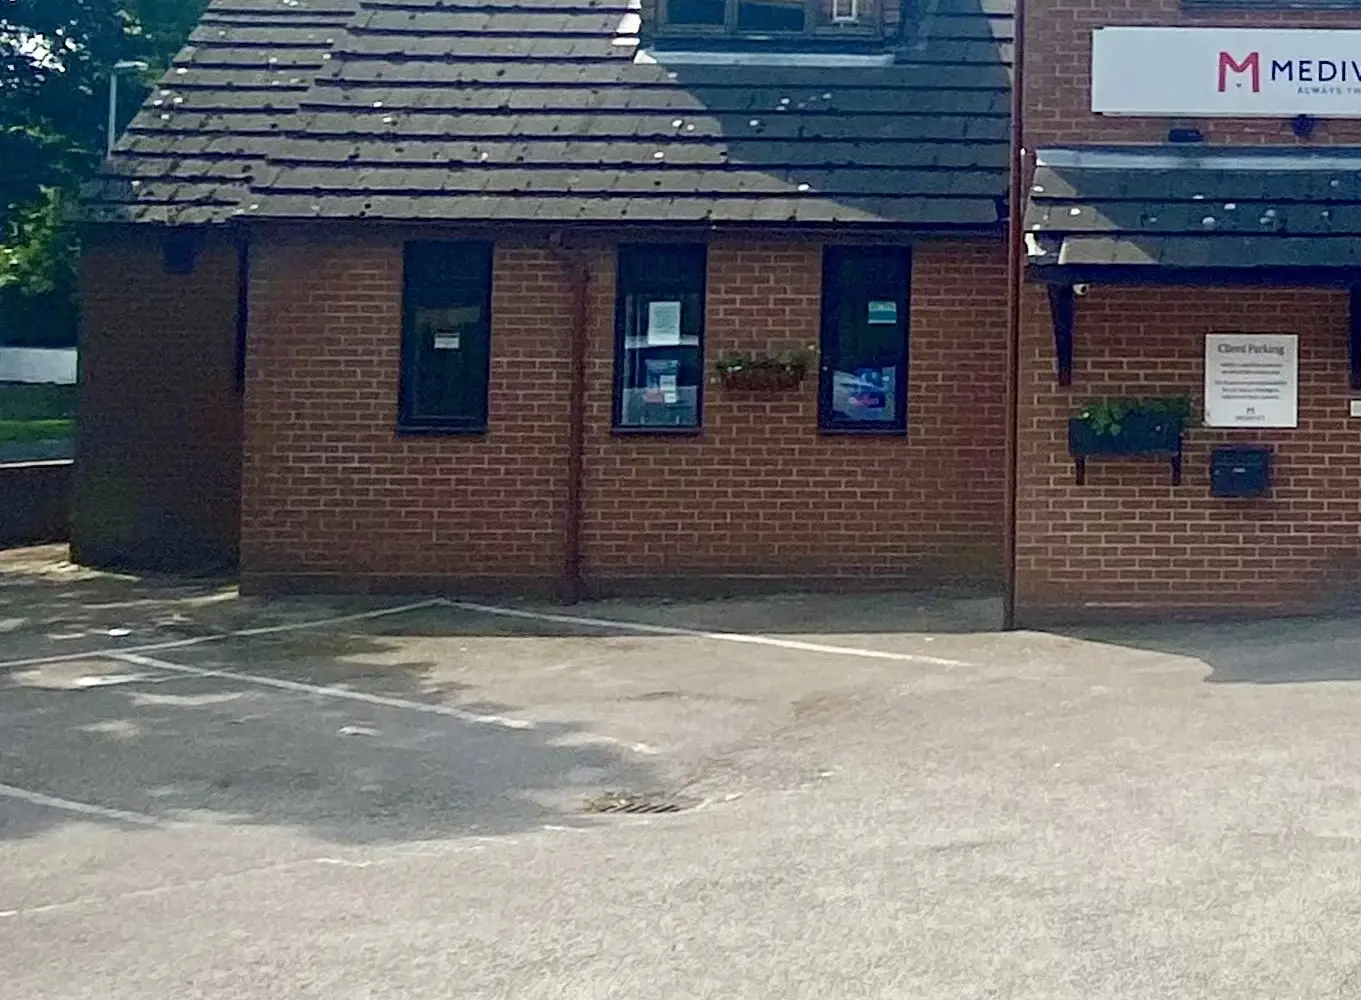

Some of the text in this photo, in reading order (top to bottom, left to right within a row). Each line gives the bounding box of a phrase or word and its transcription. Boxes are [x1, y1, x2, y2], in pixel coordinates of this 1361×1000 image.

[1218, 51, 1260, 93] M
[1296, 86, 1342, 95] ALWAYS
[1248, 343, 1285, 356] Parking
